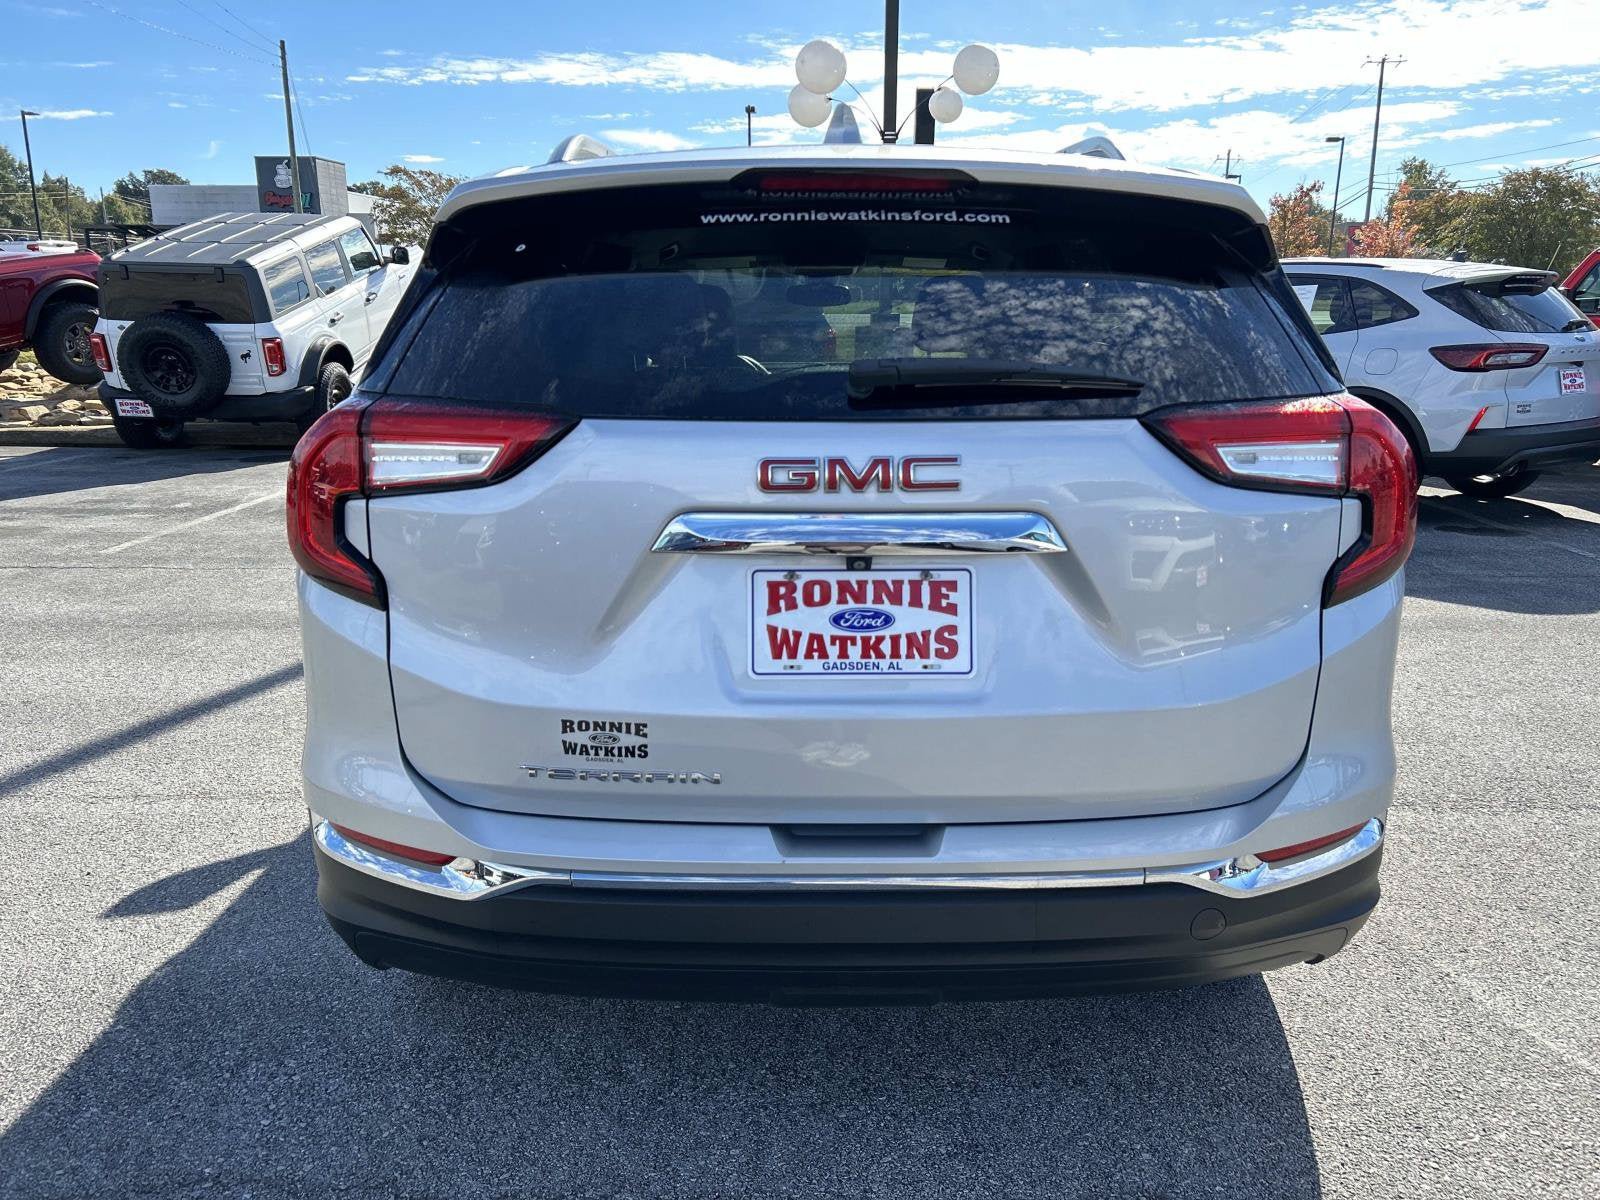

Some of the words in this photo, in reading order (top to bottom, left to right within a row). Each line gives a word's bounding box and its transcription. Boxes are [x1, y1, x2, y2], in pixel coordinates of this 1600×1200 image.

[700, 209, 1011, 224] www.ronniewatkinsford.com
[757, 455, 962, 494] GMC
[766, 579, 958, 617] RONNIE
[839, 610, 886, 628] Ford
[766, 623, 960, 660] WATKINS
[822, 661, 884, 673] GADSDEN,
[887, 661, 903, 671] AL
[561, 718, 648, 738] RONNIE
[561, 739, 649, 759] WATKINS
[519, 764, 722, 785] TERRAIN
